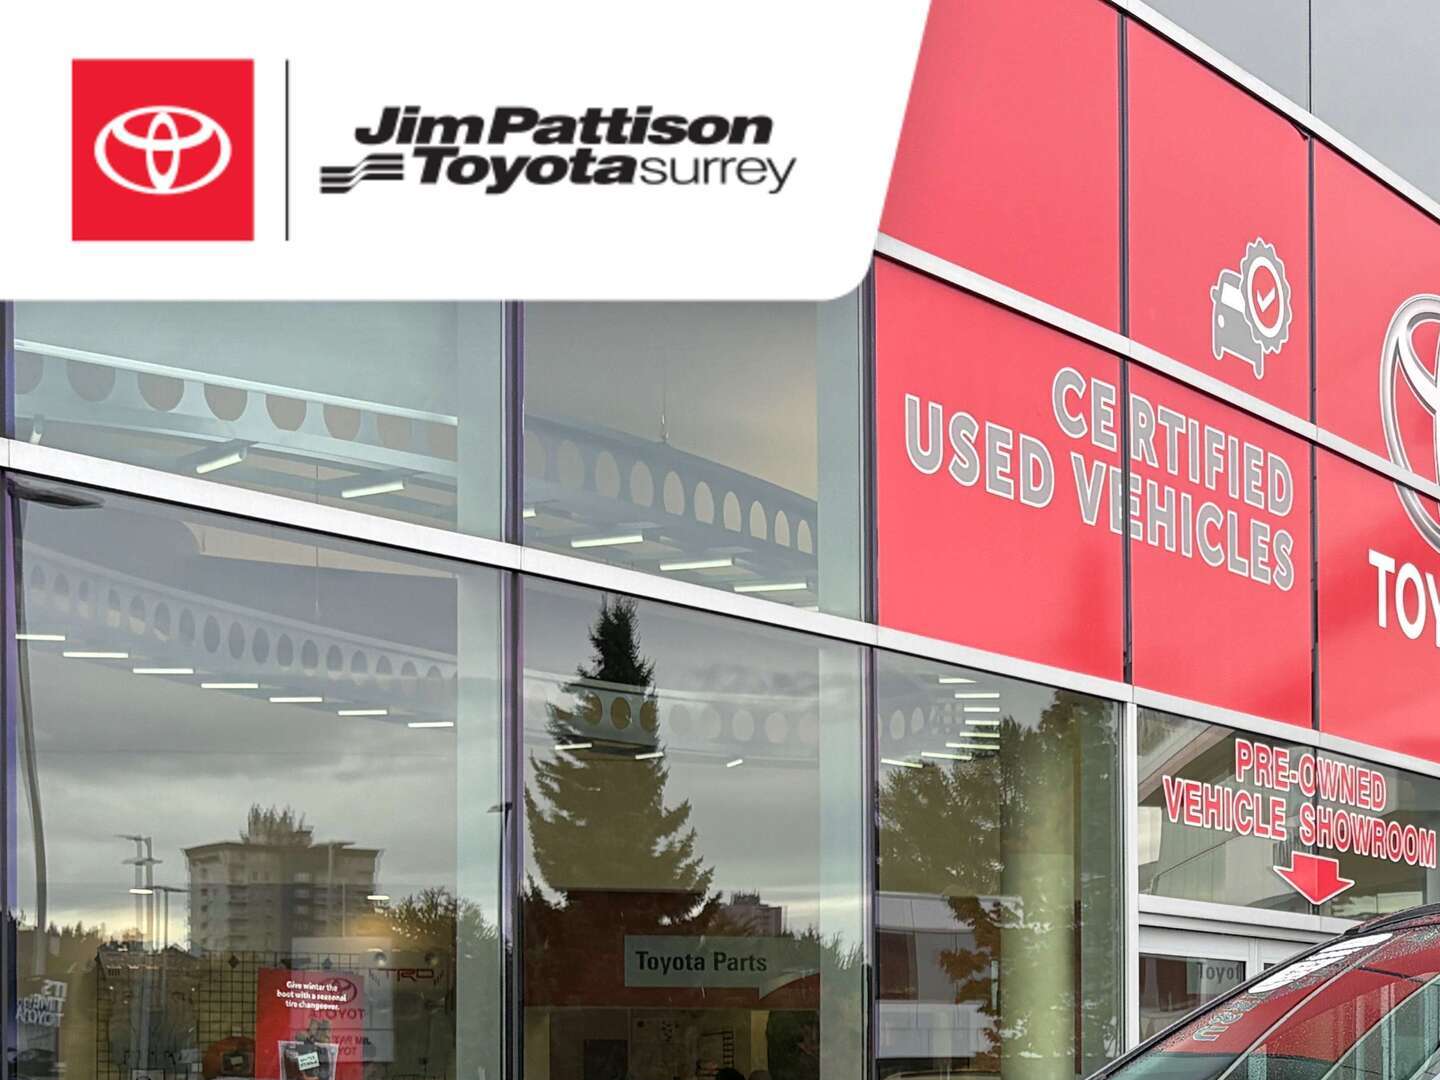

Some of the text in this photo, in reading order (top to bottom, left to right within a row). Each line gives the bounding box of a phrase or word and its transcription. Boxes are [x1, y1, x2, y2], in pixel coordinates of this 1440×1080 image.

[1052, 366, 1295, 518] CERTIFIED
[904, 393, 1295, 591] USED VEHICLES
[1235, 738, 1387, 811] PRE-OWNED
[1161, 774, 1437, 869] VEHICLE SHOWROOM
[286, 980, 338, 991] Give winter the
[635, 950, 768, 976] Toyota Parts
[276, 989, 294, 998] boot
[295, 991, 311, 1000] with
[317, 993, 348, 1002] seasonal
[285, 1000, 298, 1008] tire
